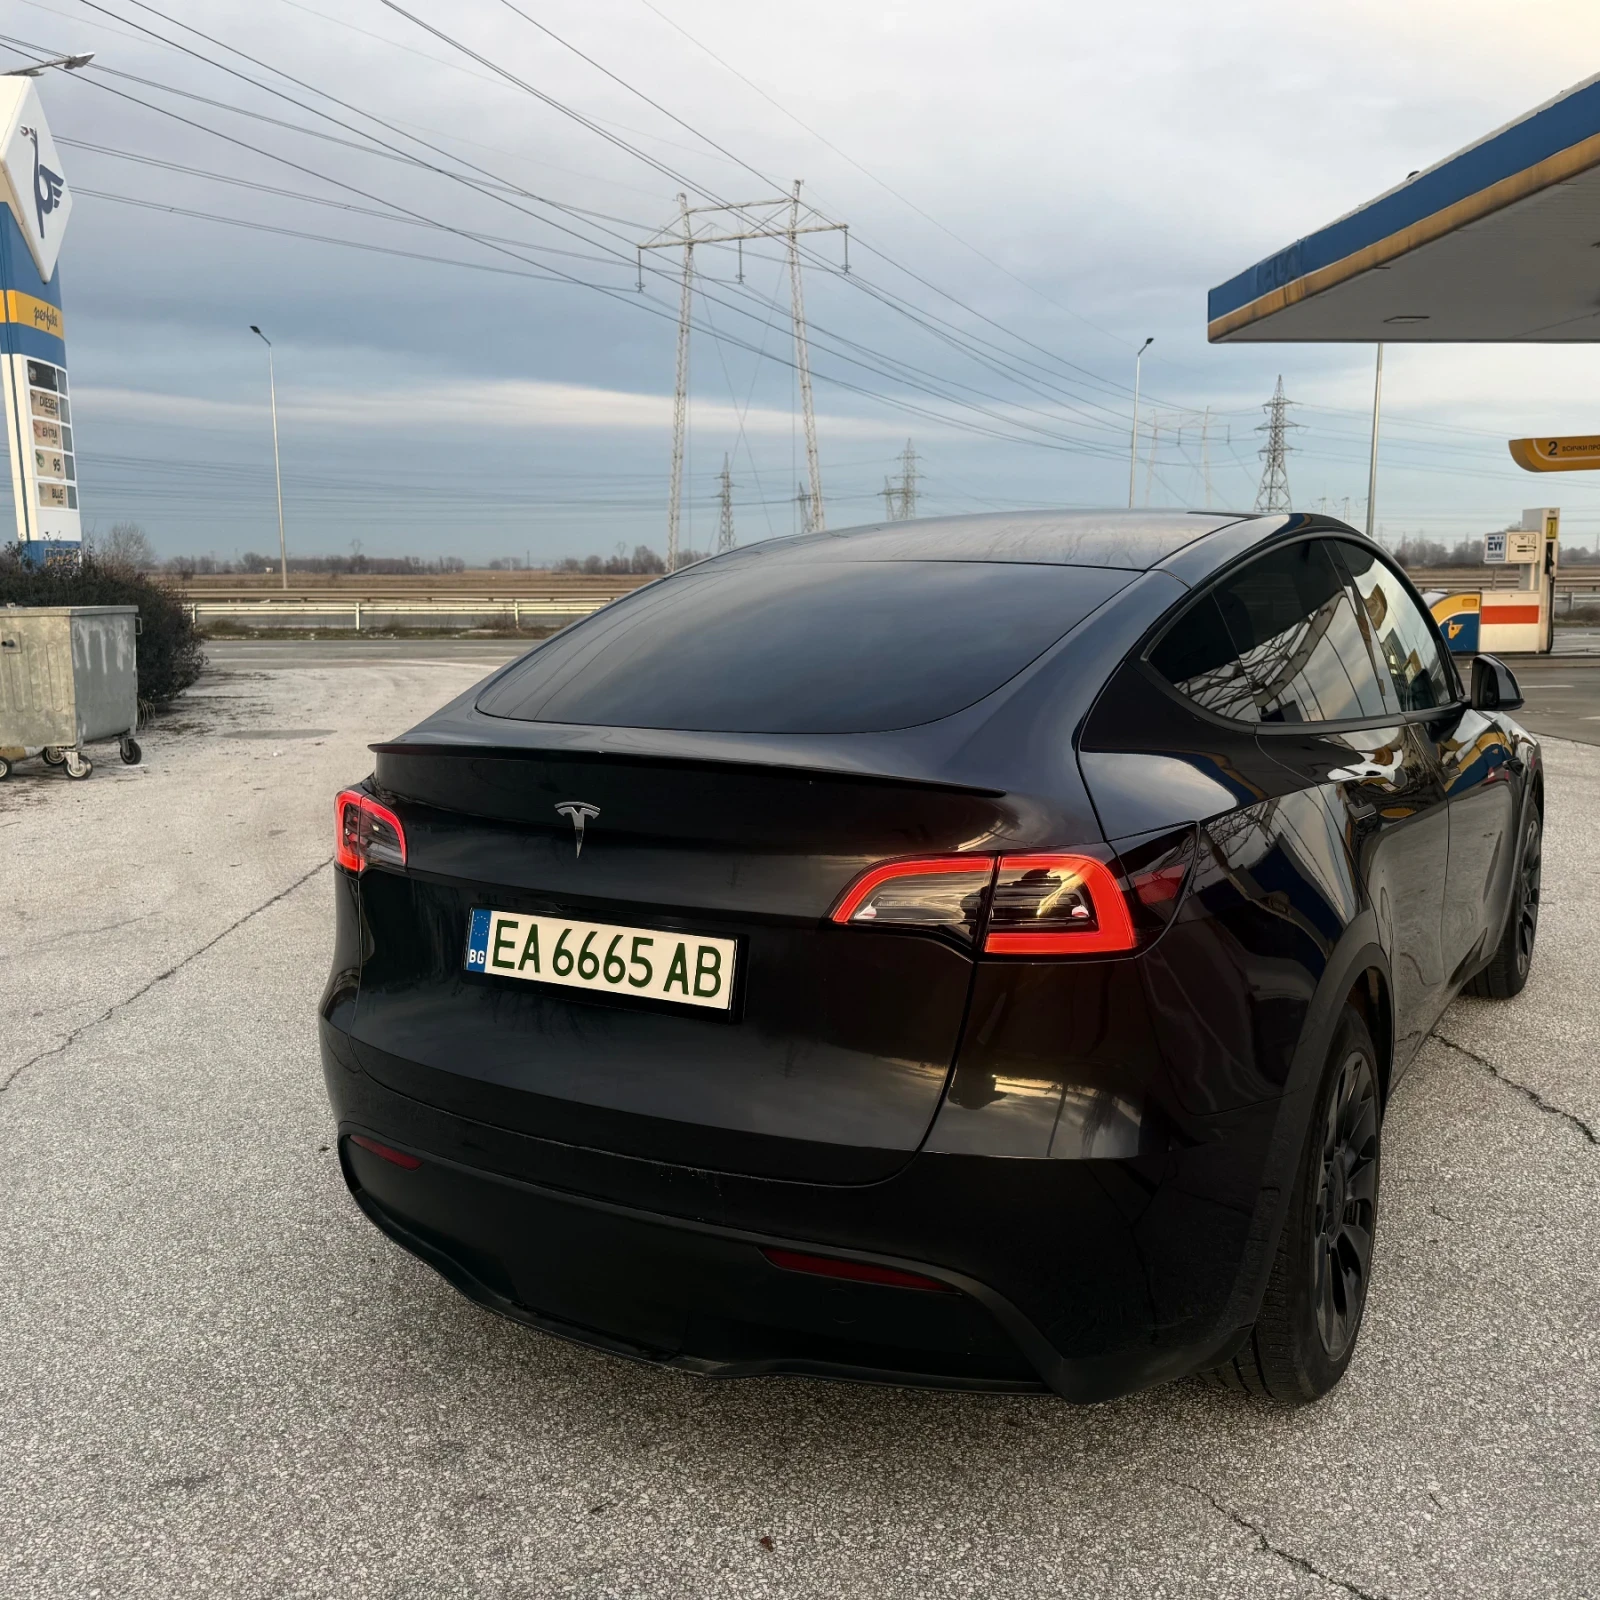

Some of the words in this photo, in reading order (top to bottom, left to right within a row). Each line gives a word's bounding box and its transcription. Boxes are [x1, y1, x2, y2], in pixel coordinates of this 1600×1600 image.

[1548, 440, 1558, 456] 2
[52, 457, 61, 472] 95
[468, 948, 486, 965] BG
[492, 918, 541, 974] EA
[552, 928, 654, 988] 6665
[663, 942, 722, 998] AB
